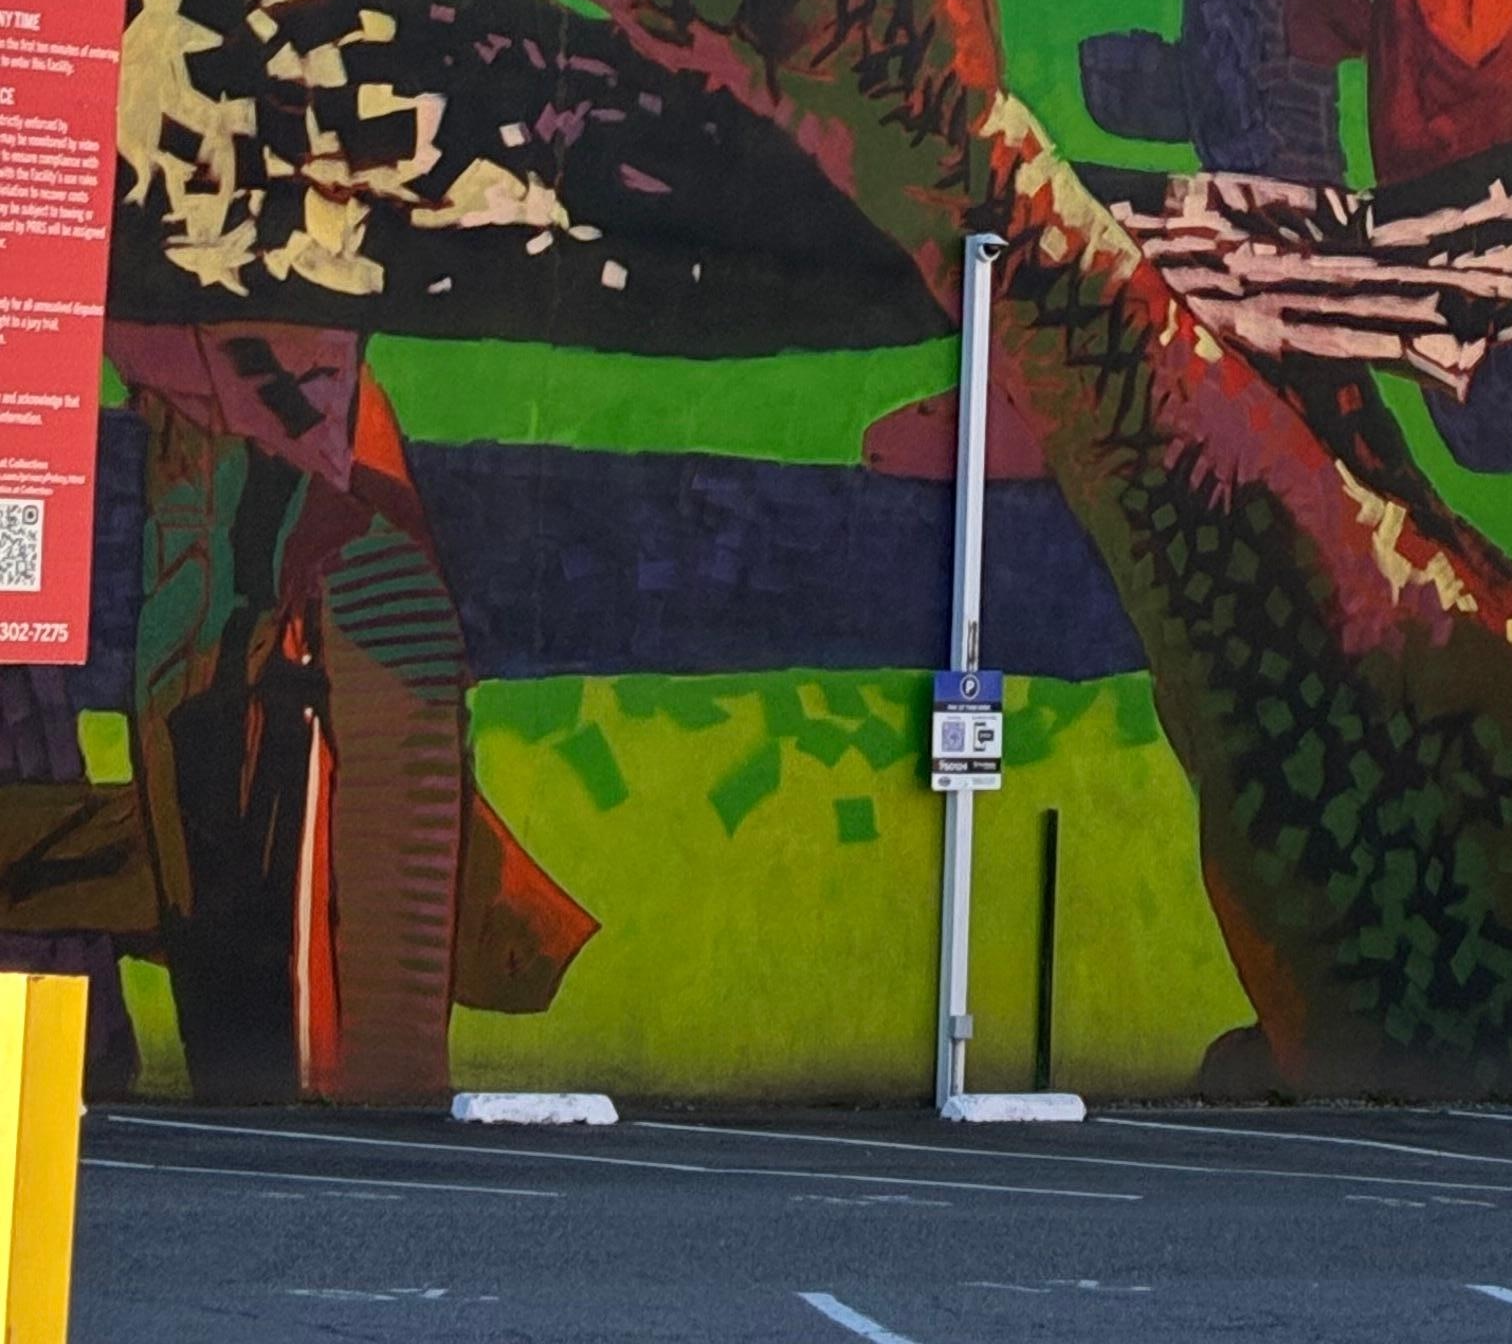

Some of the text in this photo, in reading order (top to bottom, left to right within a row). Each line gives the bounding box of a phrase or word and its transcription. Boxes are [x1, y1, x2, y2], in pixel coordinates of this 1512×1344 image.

[20, 39, 36, 52] first
[49, 43, 80, 58] minutes
[80, 44, 90, 58] of
[24, 116, 59, 131] enforced
[58, 118, 68, 135] by
[17, 133, 27, 146] be
[28, 135, 67, 150] monitored
[67, 137, 78, 153] by
[78, 139, 100, 152] video
[38, 153, 81, 168] compliance
[81, 156, 99, 169] with
[16, 167, 29, 180] the
[30, 185, 39, 199] to
[10, 199, 20, 215] be
[20, 202, 50, 218] subject
[15, 219, 25, 235] by
[61, 223, 72, 236] be
[72, 224, 106, 241] assigned
[23, 297, 34, 311] all
[17, 392, 63, 410] acknowledge
[63, 394, 80, 408] that
